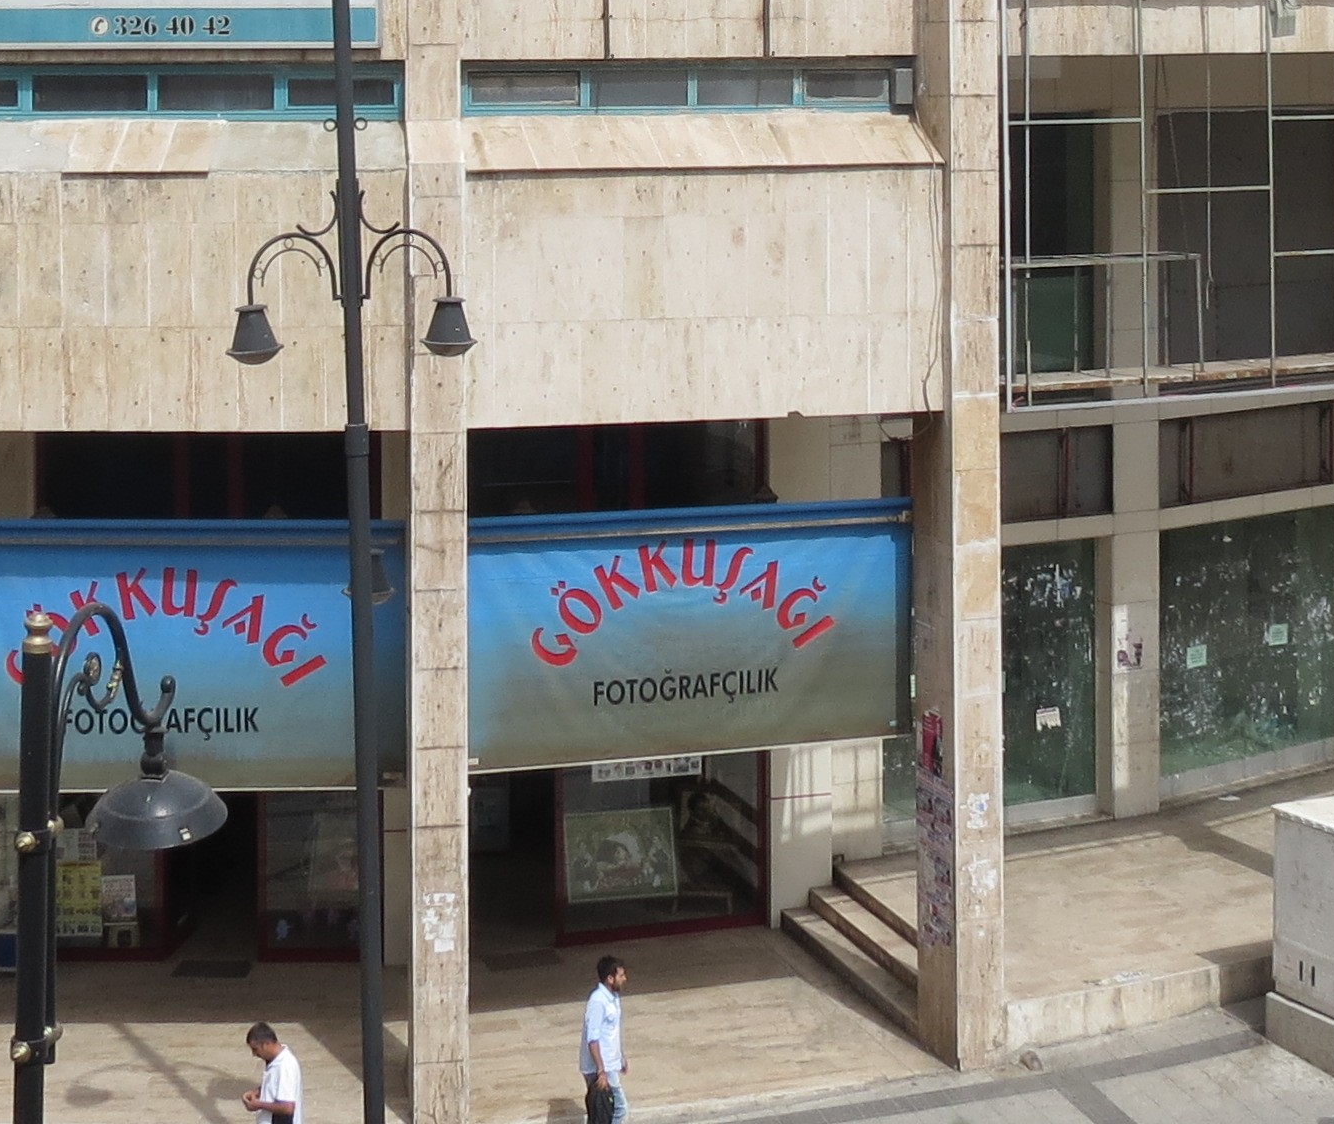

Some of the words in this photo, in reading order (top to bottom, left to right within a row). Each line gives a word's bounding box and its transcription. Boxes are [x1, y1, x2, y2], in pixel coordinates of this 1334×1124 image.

[113, 16, 157, 36] 326
[166, 16, 195, 36] 40
[202, 16, 231, 36] 42
[531, 538, 838, 668] GÖKKUŞAĞI
[591, 665, 780, 707] FOTOĞRAFÇILIK
[64, 705, 260, 741] FOTOAFÇILIK
